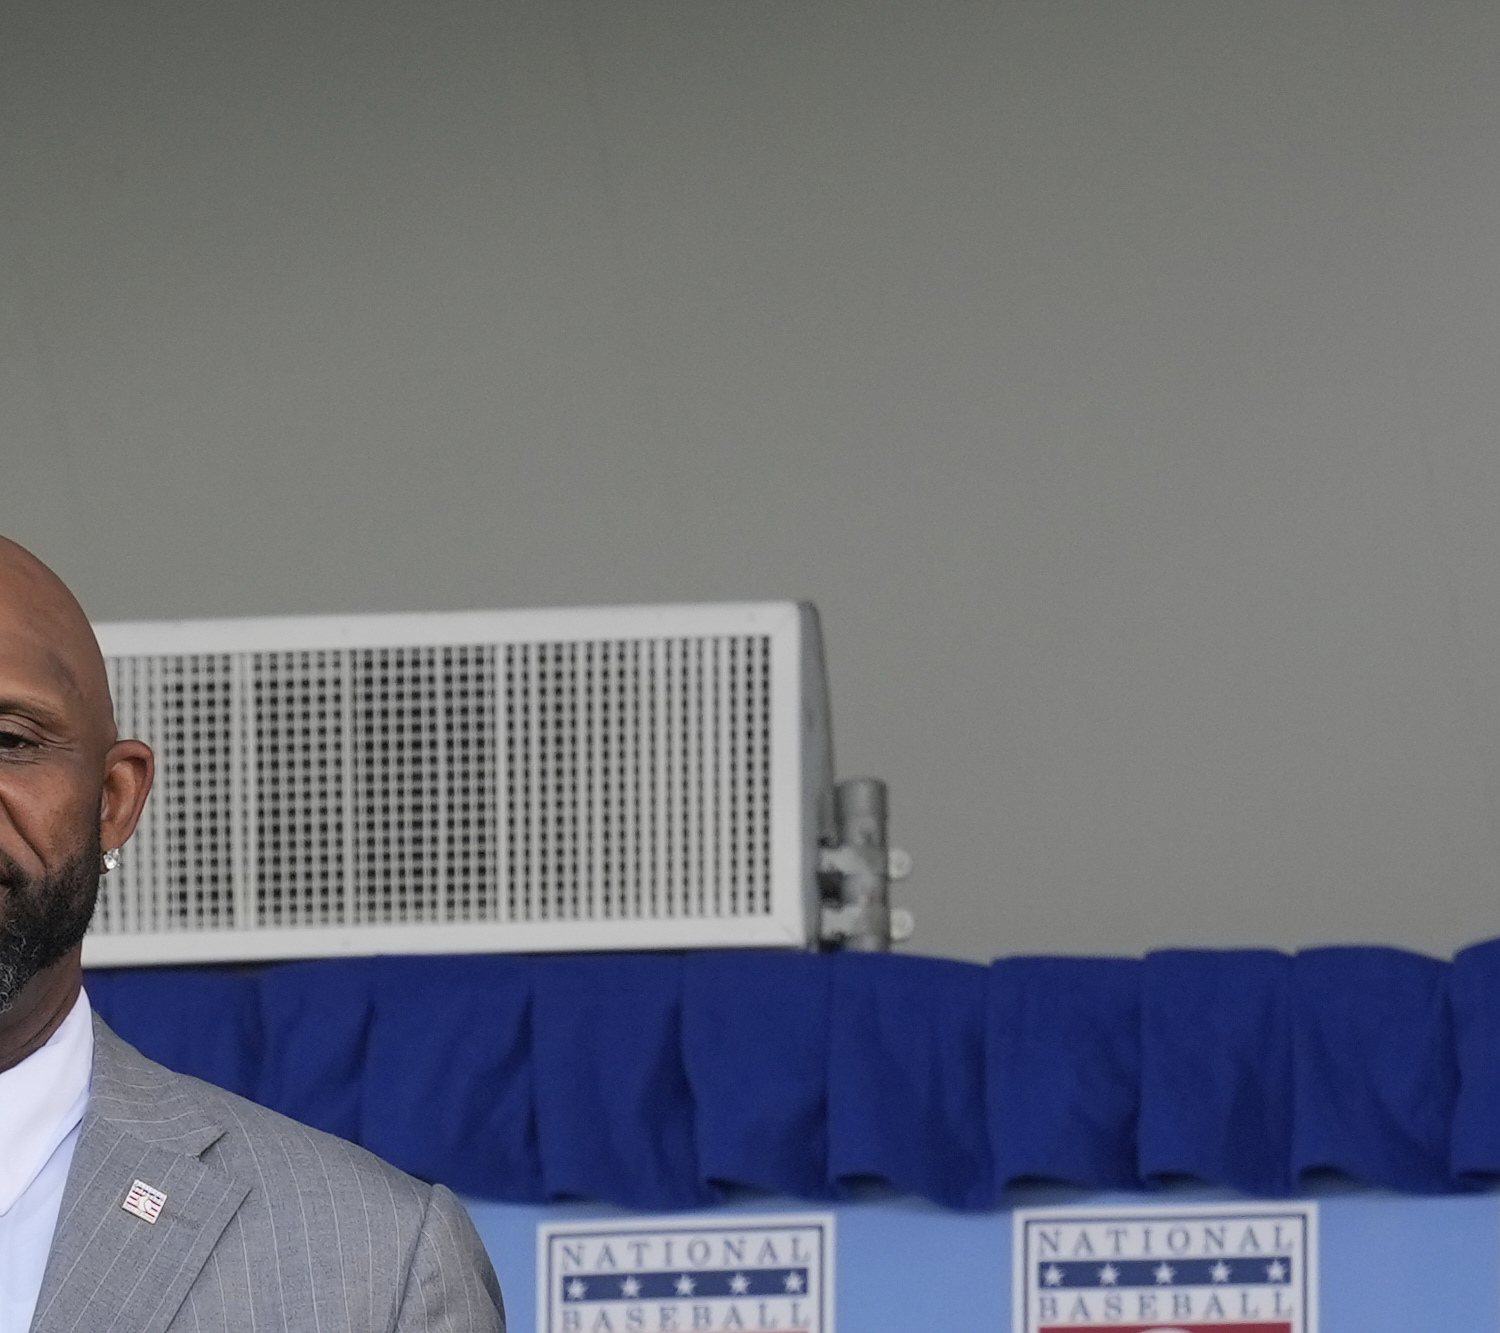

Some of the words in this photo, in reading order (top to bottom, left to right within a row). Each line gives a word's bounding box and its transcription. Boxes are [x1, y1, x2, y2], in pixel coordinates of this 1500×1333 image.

[562, 1236, 810, 1269] NATIONAL
[1039, 1224, 1293, 1257] NATIONAL
[562, 1302, 810, 1333] BASEBALL
[1039, 1290, 1293, 1322] BASEBALL
